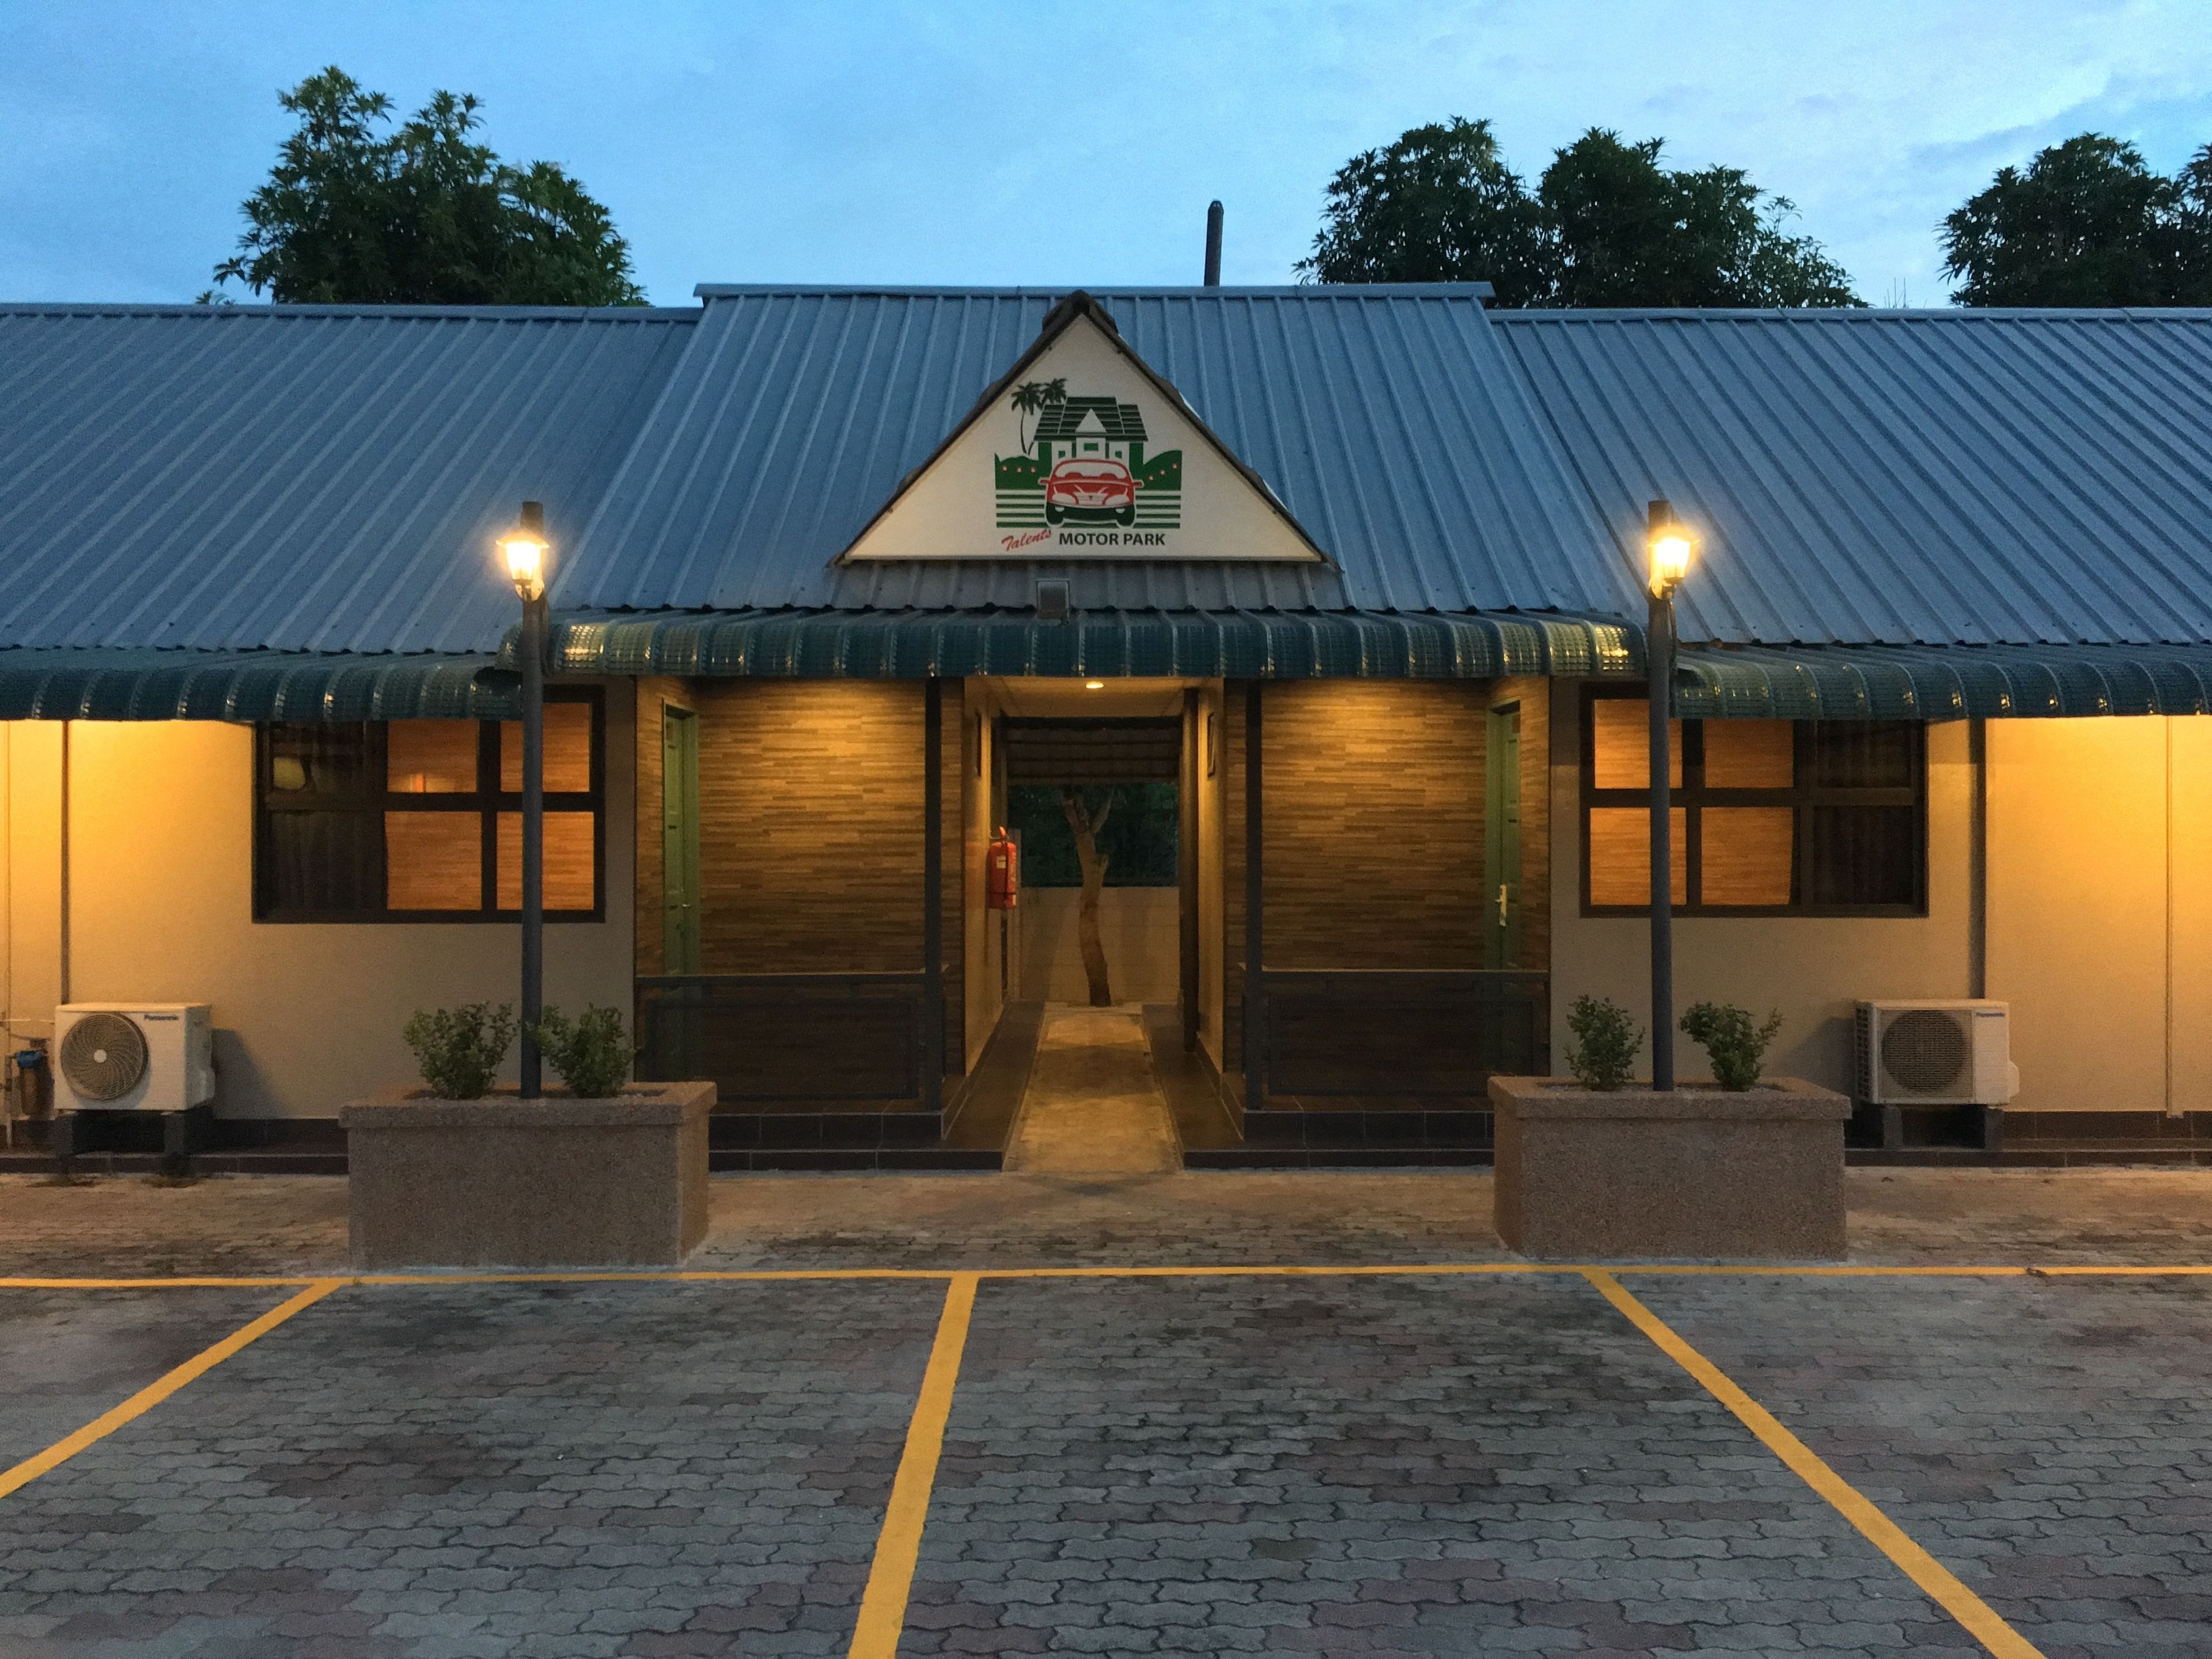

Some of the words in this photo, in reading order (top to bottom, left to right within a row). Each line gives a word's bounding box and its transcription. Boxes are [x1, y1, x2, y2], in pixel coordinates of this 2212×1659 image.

[1001, 528, 1051, 551] Talents
[1059, 533, 1119, 546] MOTOR
[1123, 533, 1166, 546] PARK
